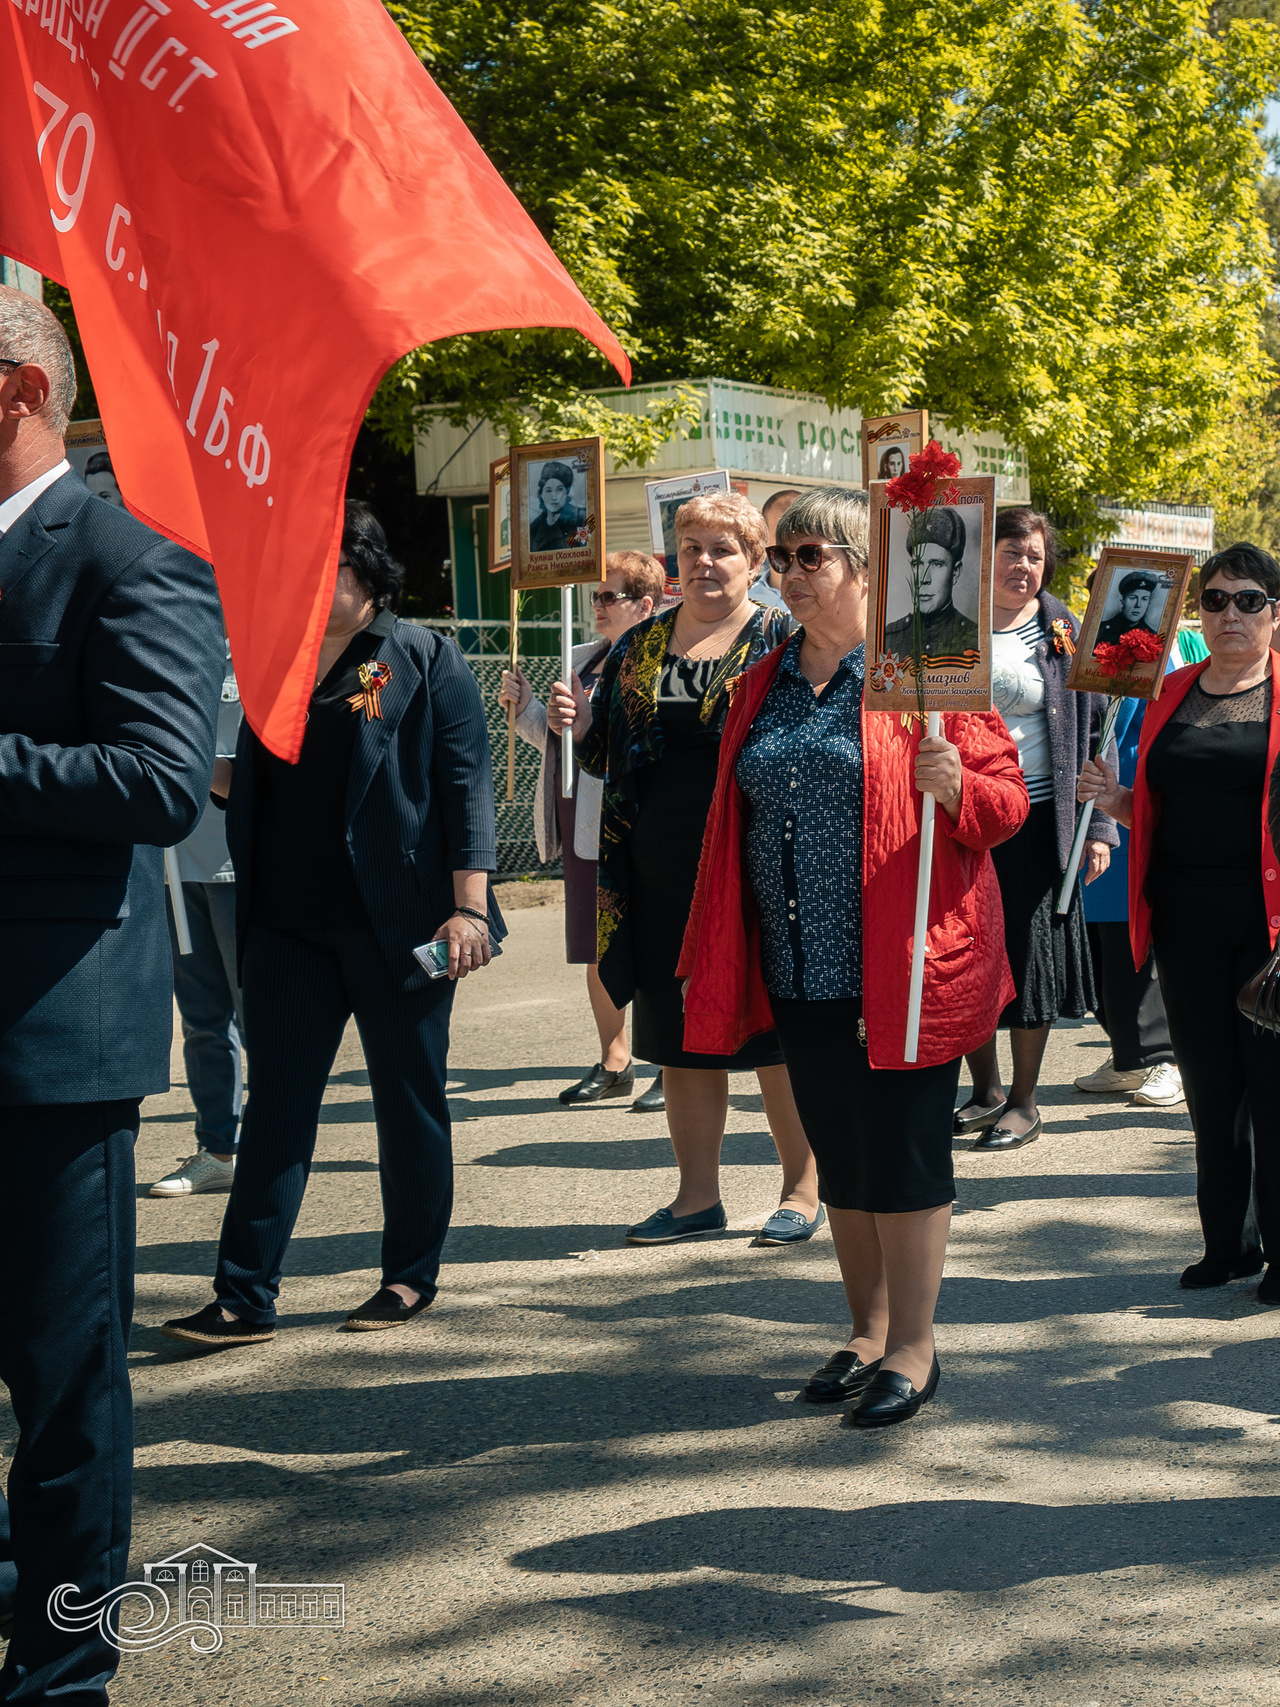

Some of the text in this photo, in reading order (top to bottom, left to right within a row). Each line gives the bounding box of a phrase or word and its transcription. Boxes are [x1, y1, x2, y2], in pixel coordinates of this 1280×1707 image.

[33, 80, 96, 233] 79
[203, 385, 275, 507] Б.Ф.
[529, 548, 592, 564] Кулиш (Хохлова)
[527, 559, 595, 572] Раиса Николаевна
[916, 671, 971, 687] Смазнов
